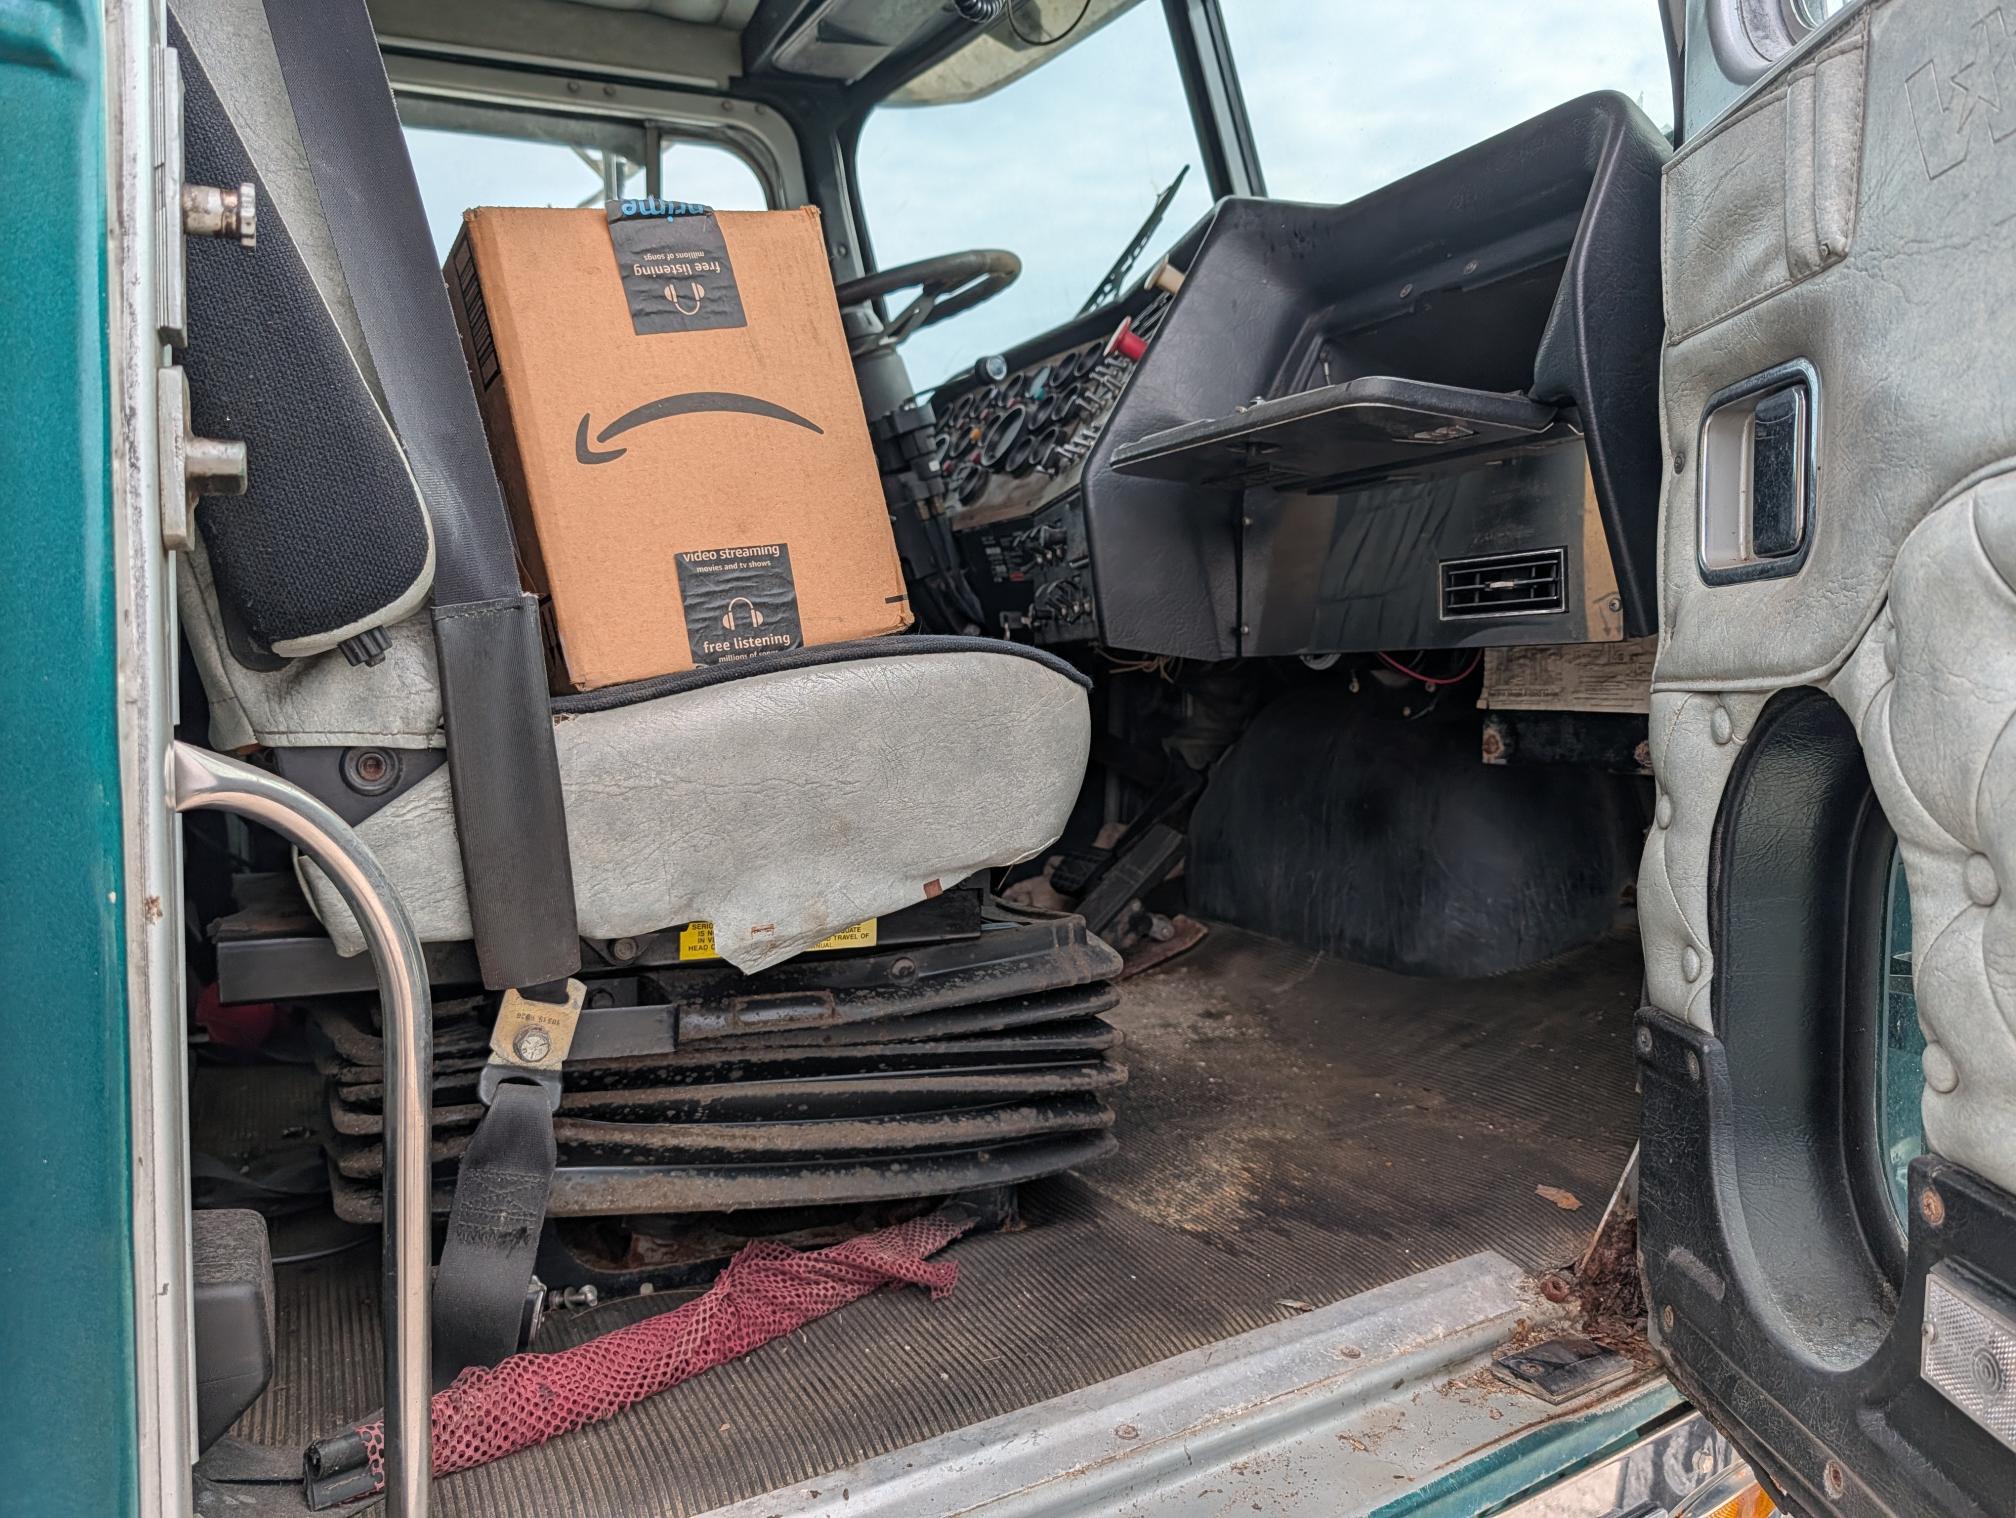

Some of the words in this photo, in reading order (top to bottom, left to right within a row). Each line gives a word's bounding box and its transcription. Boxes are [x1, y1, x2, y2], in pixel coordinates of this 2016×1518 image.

[643, 253, 666, 261] songs
[667, 252, 675, 261] of
[675, 251, 705, 260] millions
[633, 263, 693, 278] listening
[694, 262, 721, 274] free
[683, 550, 717, 562] video
[719, 545, 780, 557] streaming
[696, 565, 723, 573] movies
[724, 563, 738, 571] and
[748, 560, 771, 568] shows
[703, 640, 731, 653] free
[733, 634, 791, 650] listening
[833, 933, 859, 941] TRAVEL
